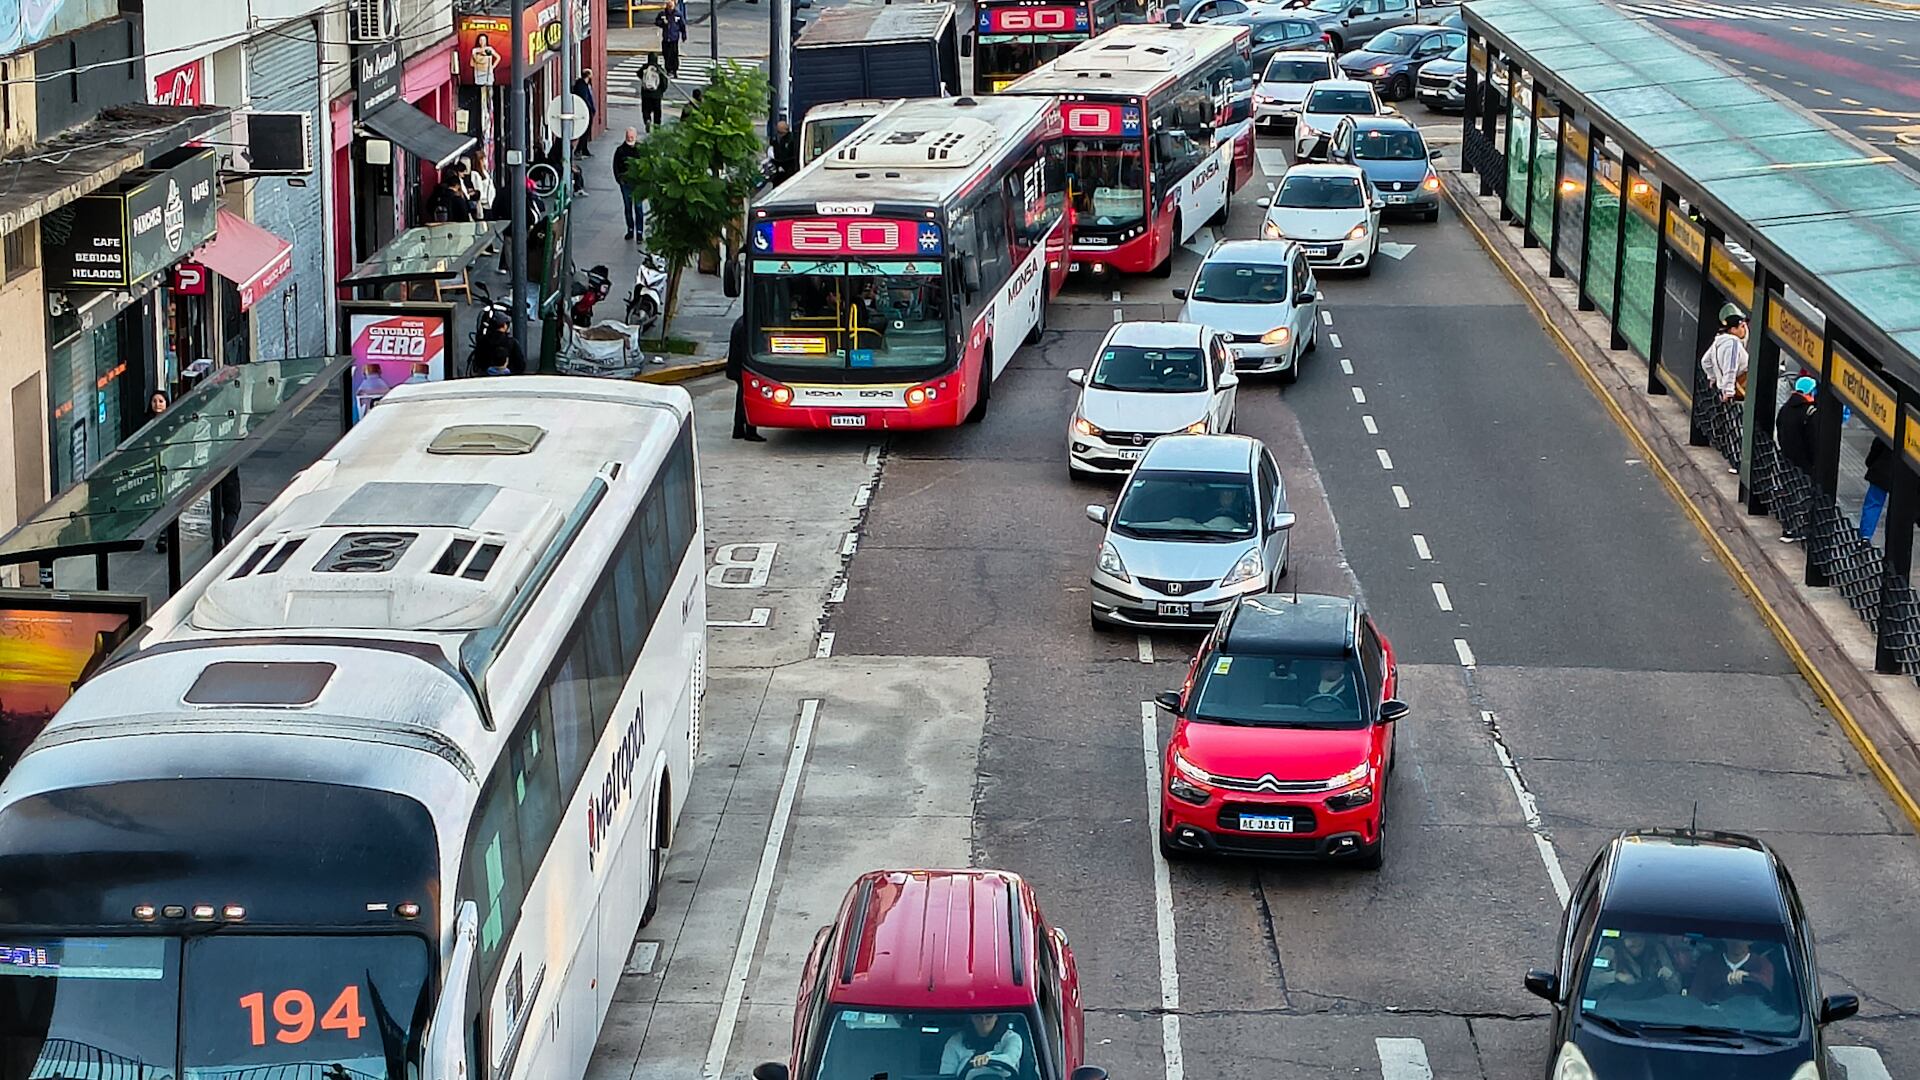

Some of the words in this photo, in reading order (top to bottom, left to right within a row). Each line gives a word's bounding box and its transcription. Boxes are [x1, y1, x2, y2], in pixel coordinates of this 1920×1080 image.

[1001, 10, 1065, 29] 60
[1192, 160, 1219, 194] MONSA
[93, 238, 120, 247] CAFE
[791, 221, 899, 250] 60
[75, 253, 121, 263] BEBIDAS
[1008, 257, 1038, 303] MONSA
[367, 336, 425, 355] ZERO
[369, 327, 424, 336] GATORADE
[1780, 309, 1804, 347] General
[1804, 328, 1815, 358] Paz
[1843, 369, 1869, 408] metrobus
[1871, 394, 1887, 423] Norte
[595, 690, 646, 853] Metropol
[1242, 819, 1254, 829] AE
[239, 985, 367, 1046] 194
